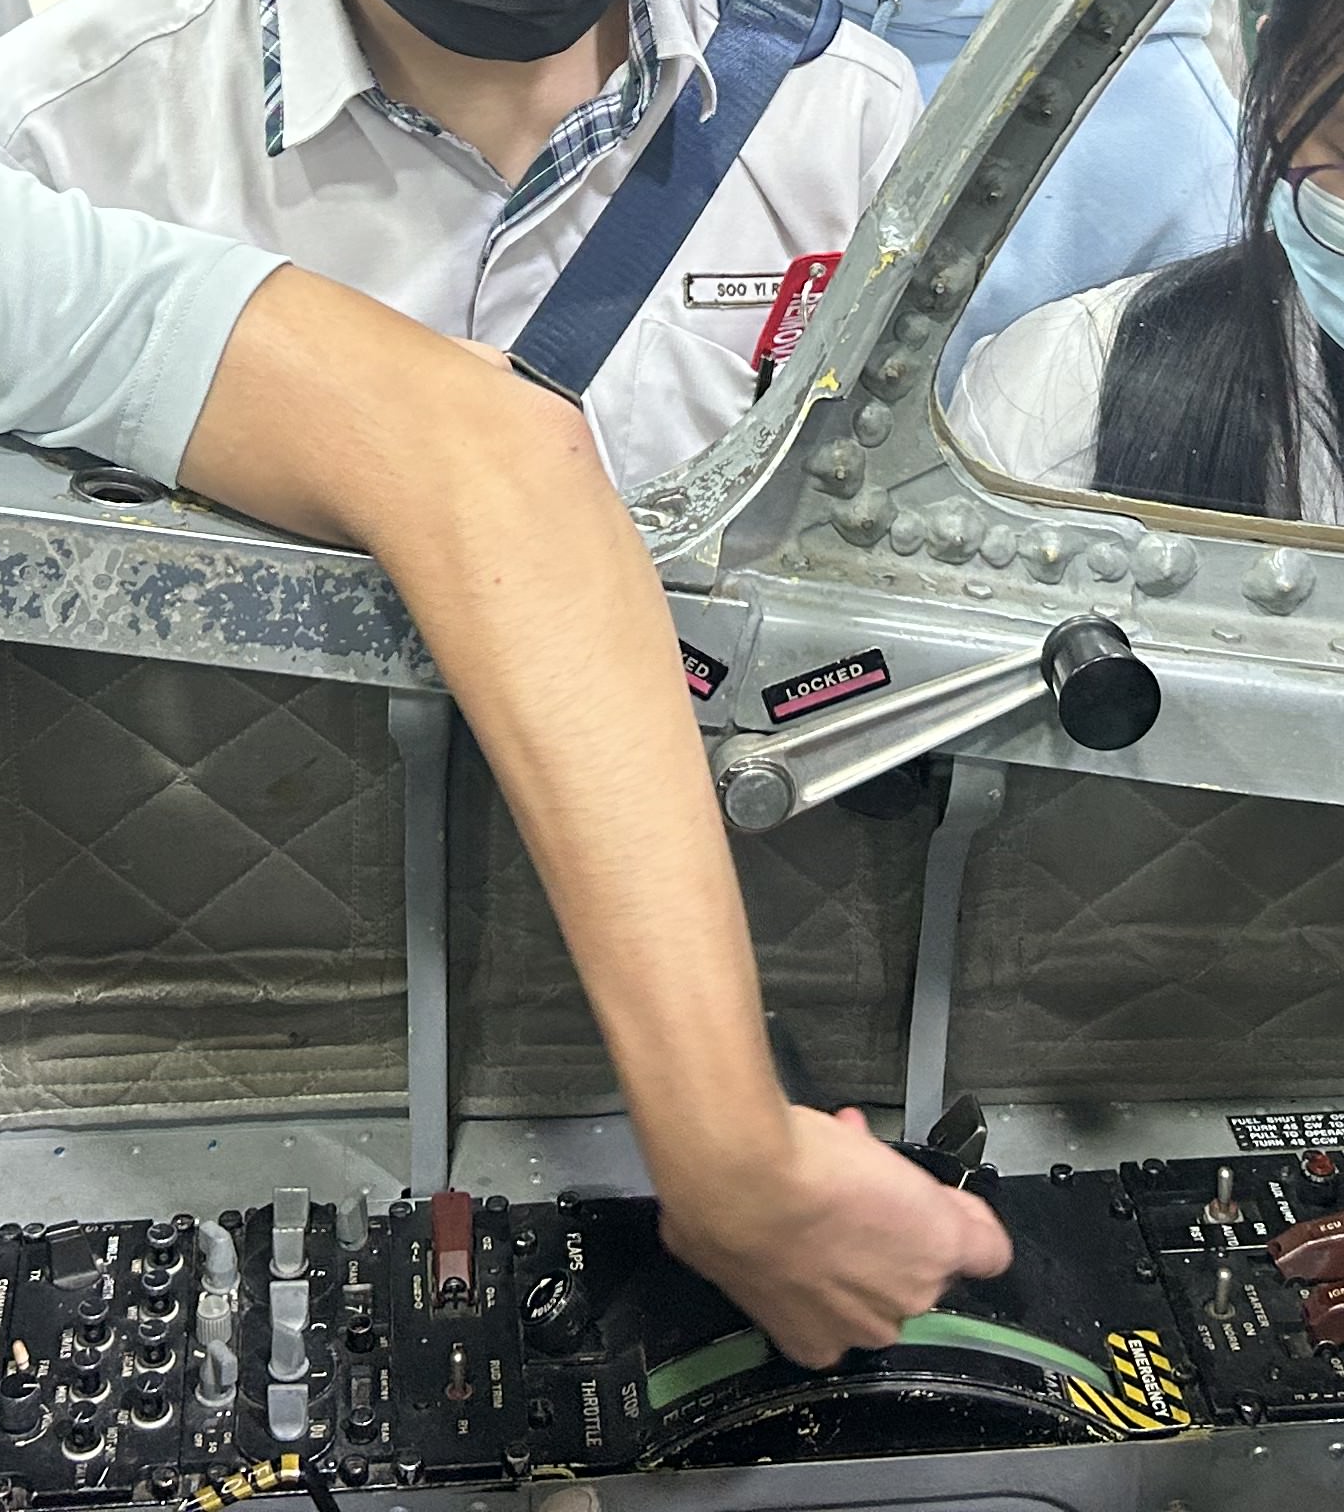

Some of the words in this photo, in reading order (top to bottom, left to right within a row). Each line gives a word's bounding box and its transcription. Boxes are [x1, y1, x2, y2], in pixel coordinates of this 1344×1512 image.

[717, 283, 747, 297] SOO
[756, 283, 766, 296] YI
[772, 283, 781, 294] R
[785, 663, 864, 701] LOCKED
[1231, 1117, 1261, 1126] FUEL
[1267, 1115, 1295, 1124] SHUT
[1302, 1114, 1324, 1122] OFF
[1246, 1124, 1277, 1132] TURN
[1304, 1121, 1322, 1129] CW
[1328, 1121, 1344, 1129] TO
[1250, 1131, 1278, 1140] PULL
[1284, 1130, 1299, 1138] TO
[1253, 1139, 1284, 1148] TURN
[1311, 1137, 1338, 1145] CCW
[1268, 1181, 1285, 1203] AUX
[1277, 1202, 1296, 1225] PUMP
[1188, 1226, 1204, 1242] RST
[1221, 1225, 1239, 1247] AUTO
[1253, 1222, 1266, 1236] ON
[1319, 1220, 1342, 1232] ECU
[567, 1232, 585, 1271] FLAPS
[29, 1270, 41, 1281] TX
[349, 1261, 358, 1284] CHAN
[1244, 1284, 1270, 1328] STARTER
[1197, 1324, 1215, 1351] STOP
[1221, 1323, 1241, 1352] NORM
[1242, 1321, 1257, 1336] ON
[37, 1359, 50, 1377] FAIL
[489, 1359, 501, 1381] RUD
[1127, 1339, 1170, 1418] EMERGENCY
[491, 1385, 503, 1409] TRIM
[622, 1382, 640, 1419] STOP
[581, 1379, 602, 1448] THROTTLE
[381, 1422, 389, 1443] READ
[457, 1419, 468, 1435] RH
[194, 1432, 203, 1448] OFF
